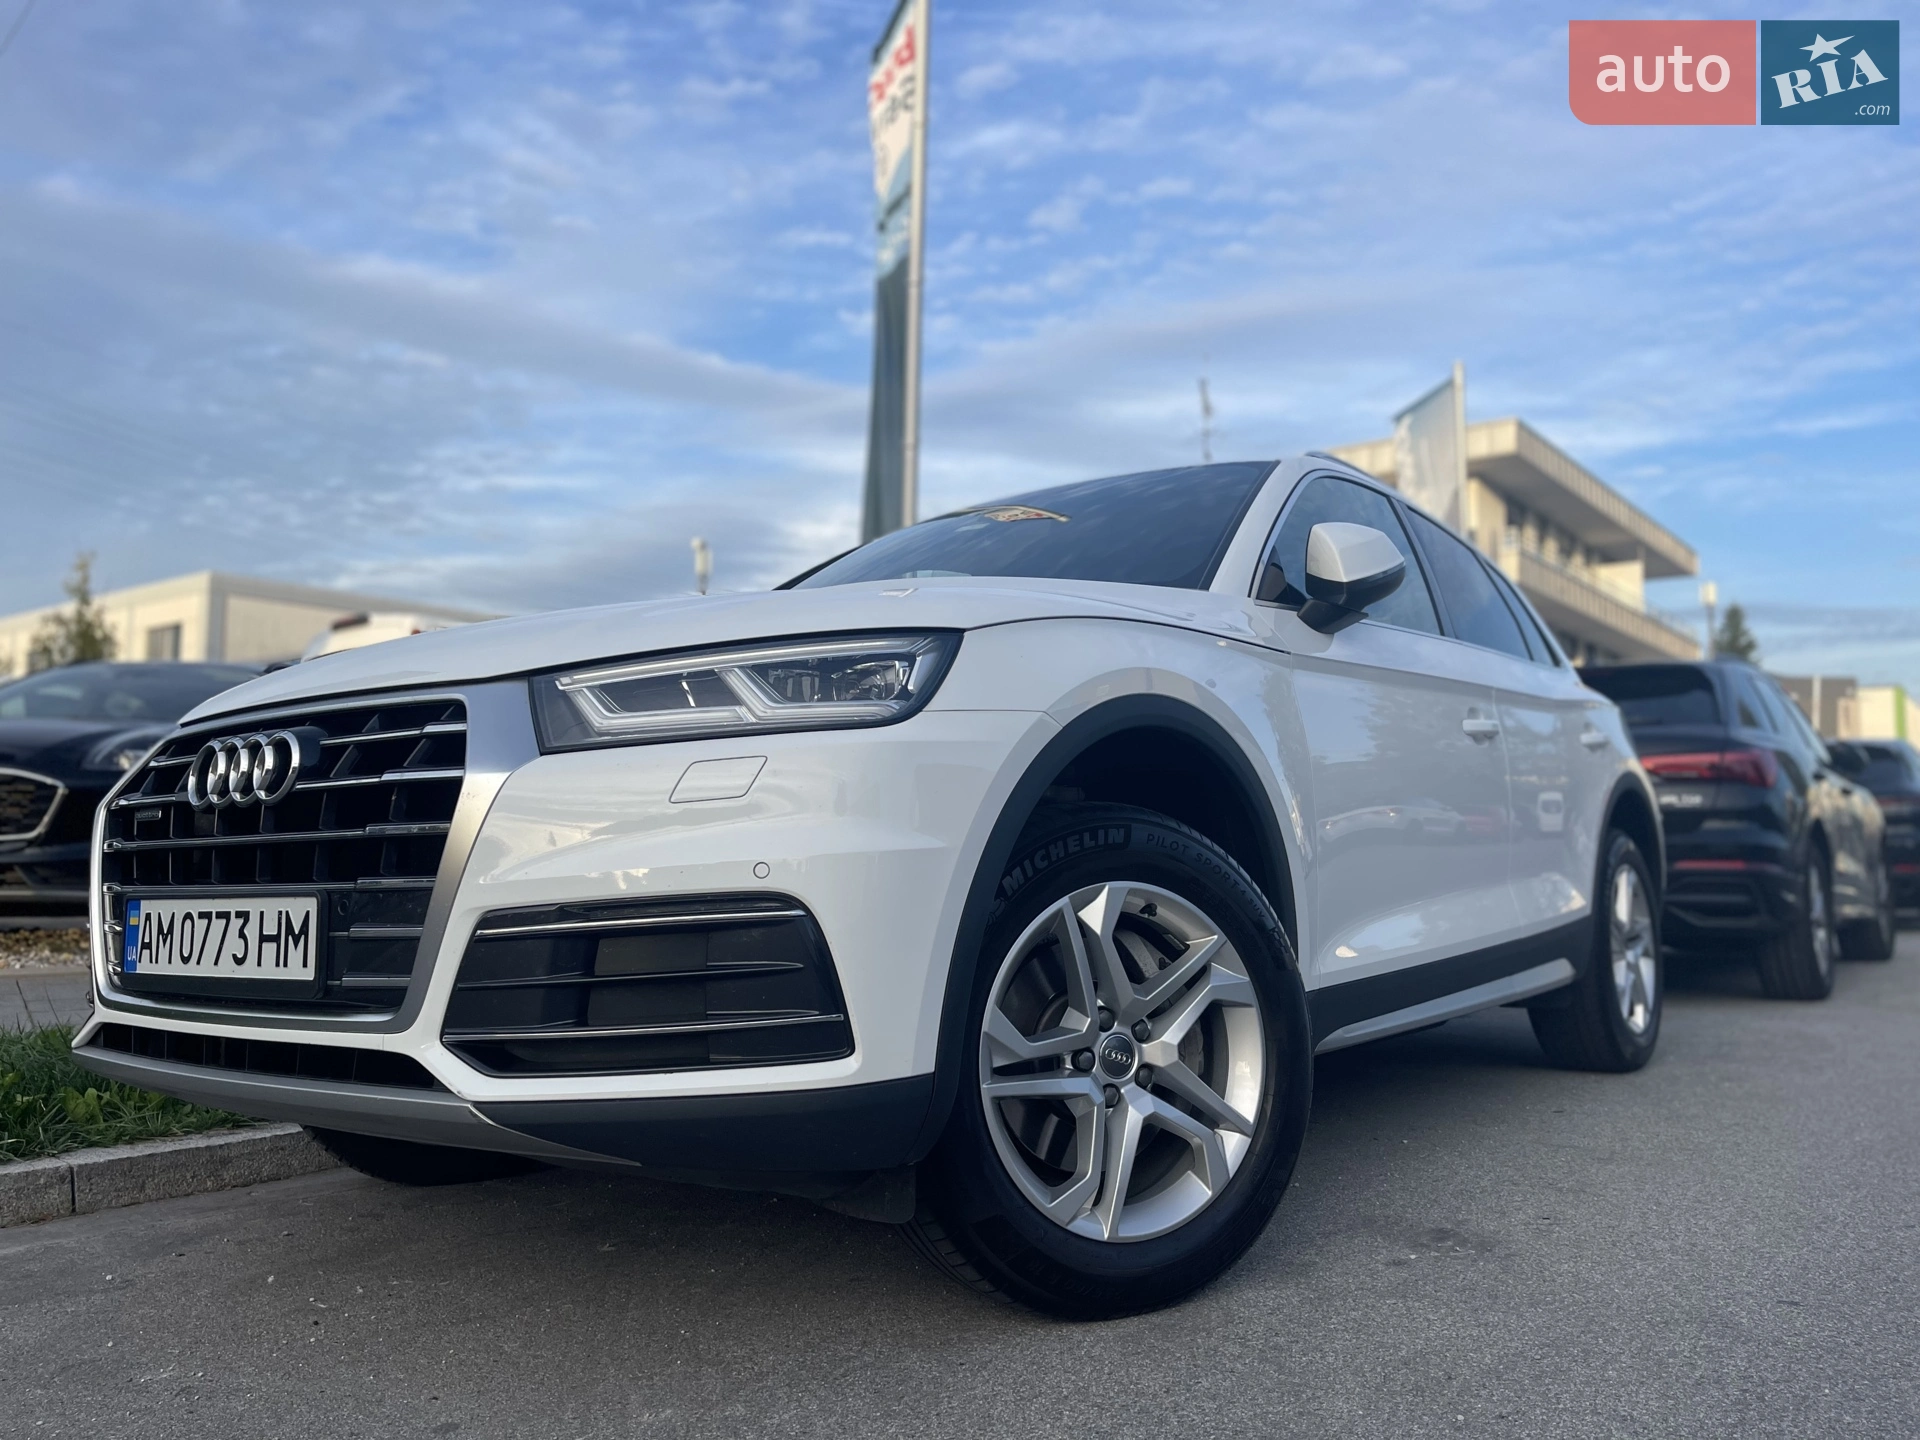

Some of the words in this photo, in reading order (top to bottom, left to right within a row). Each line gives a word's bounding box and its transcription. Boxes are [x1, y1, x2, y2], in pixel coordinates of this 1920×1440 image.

[1001, 827, 1125, 897] MICHELIN
[1146, 833, 1190, 856] PILOT
[1194, 851, 1240, 889] SPORT
[1248, 898, 1266, 918] SUV
[127, 945, 137, 962] UA
[138, 911, 176, 965] AM
[179, 909, 251, 966] 0773
[256, 909, 310, 968] HM
